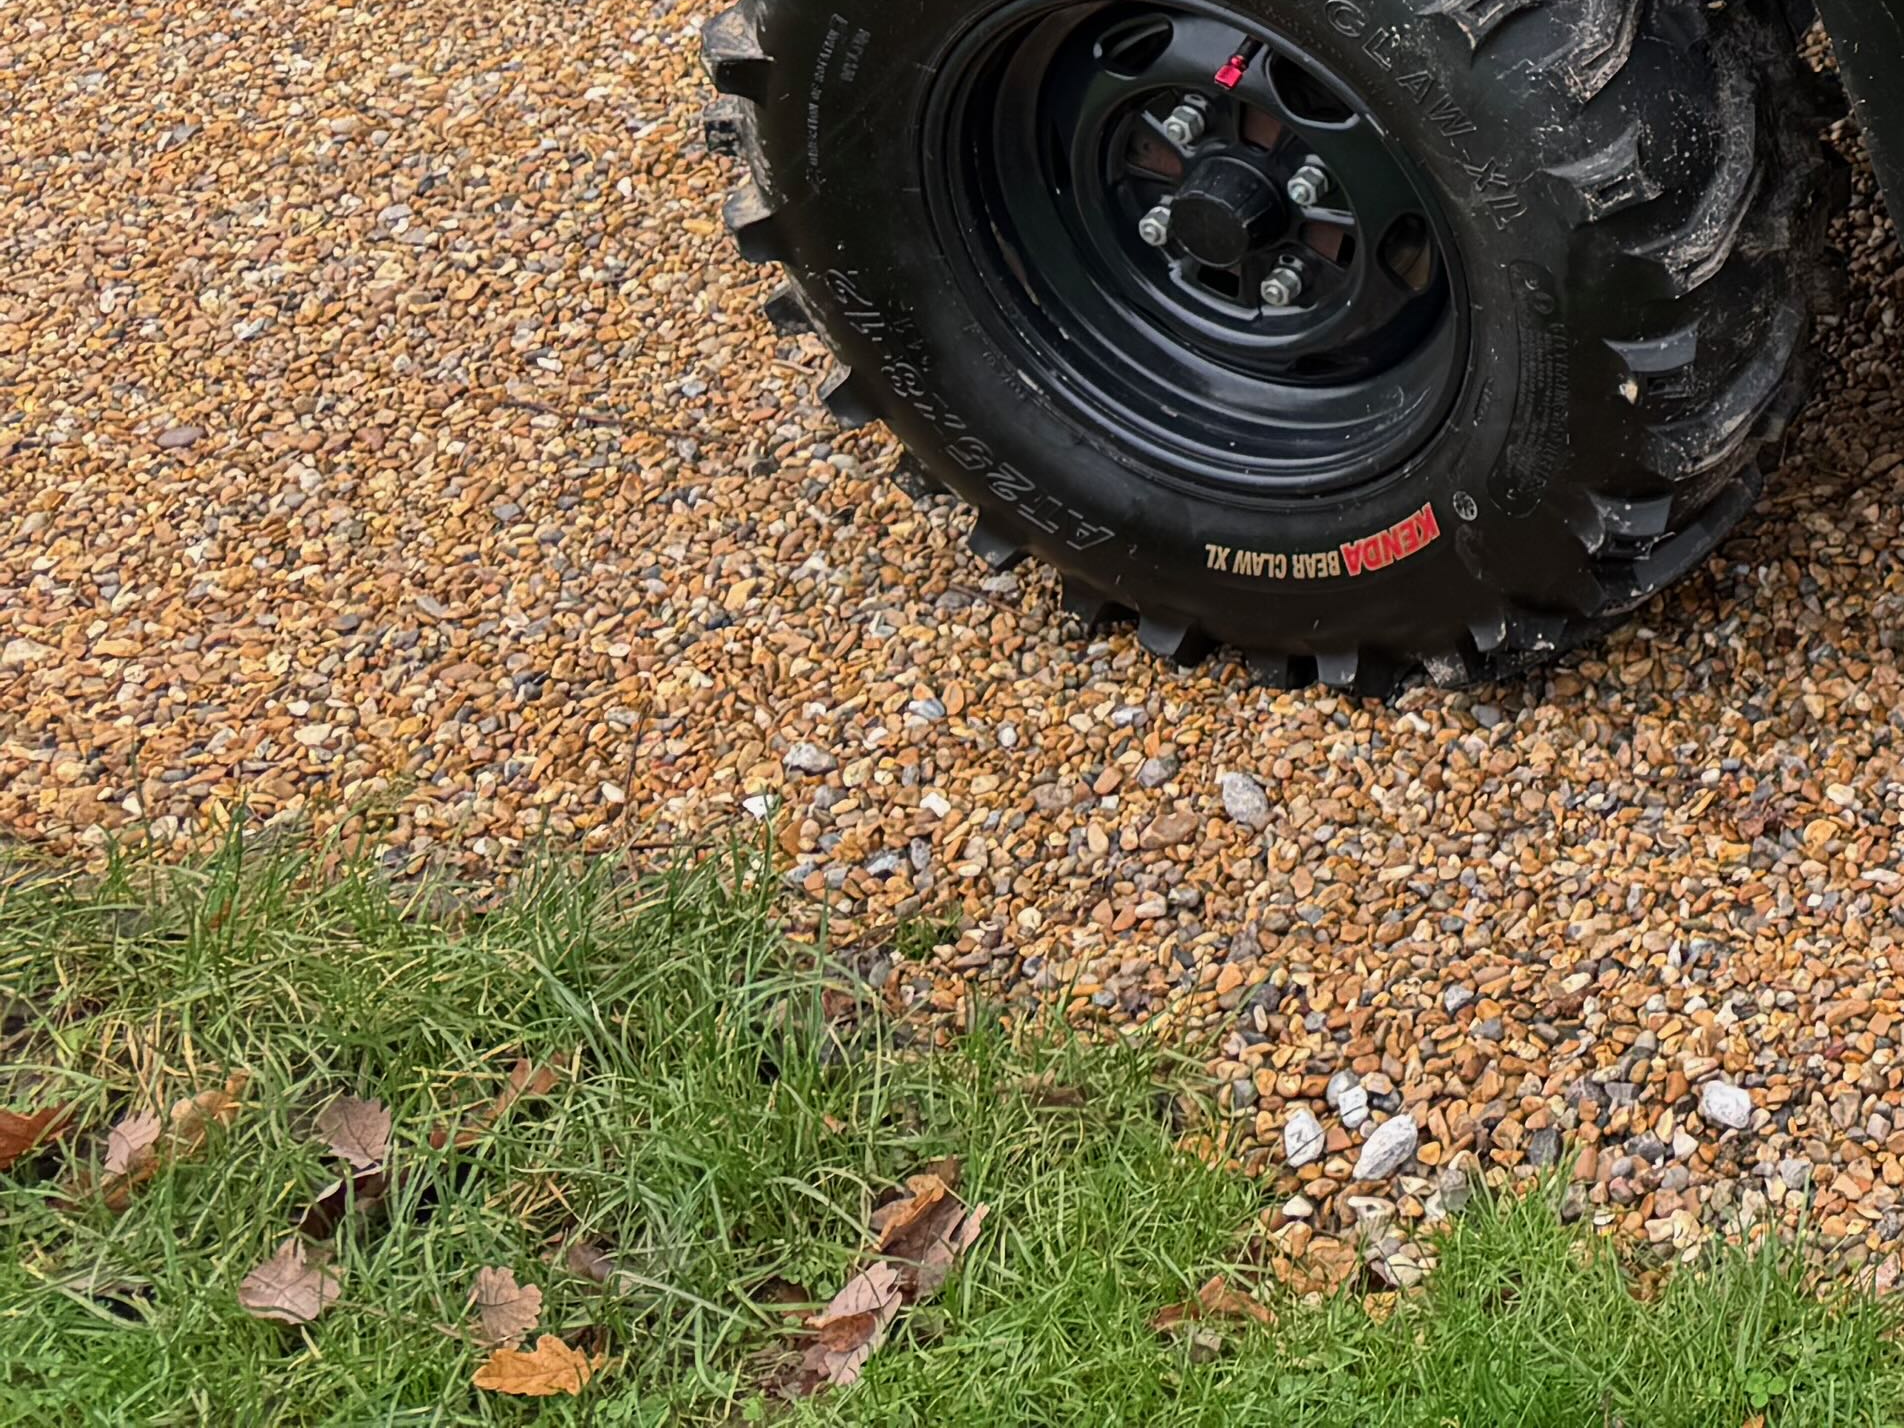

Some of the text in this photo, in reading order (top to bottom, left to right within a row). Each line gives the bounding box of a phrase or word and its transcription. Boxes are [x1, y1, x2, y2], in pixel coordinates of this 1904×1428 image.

[1340, 501, 1441, 577] KENDA
[1204, 543, 1231, 571] XL
[1231, 549, 1288, 580] CLAW
[1292, 550, 1341, 580] BEAR
